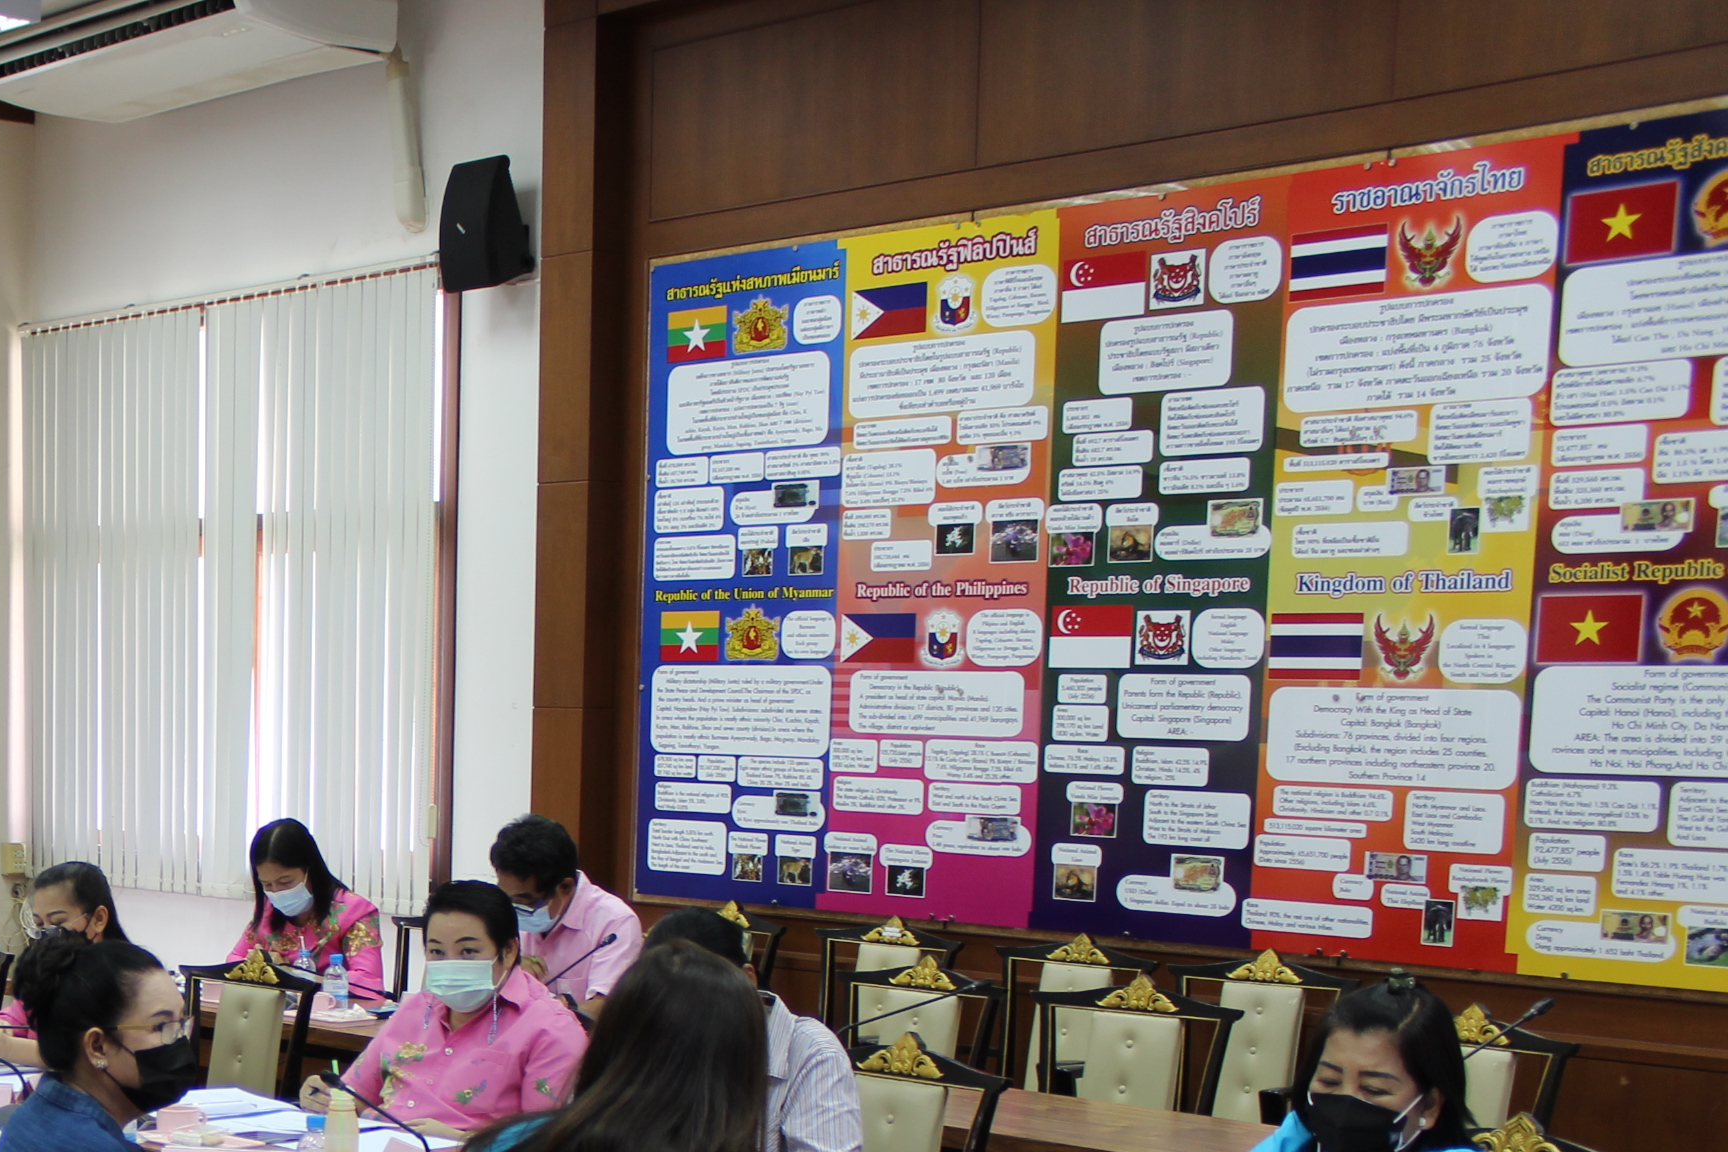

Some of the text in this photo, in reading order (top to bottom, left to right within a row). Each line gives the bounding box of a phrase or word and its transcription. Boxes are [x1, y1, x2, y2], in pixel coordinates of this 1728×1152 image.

[1332, 161, 1524, 214] ราชอาณาจักรไทย
[1085, 195, 1262, 248] สาธารณรัฐสิงคโปร์
[872, 227, 1038, 276] สาธารณรัฐฟิลิปปินส์
[666, 260, 841, 300] สาธารณรัฐแห่งสหภาพเมียนมาร์
[1068, 574, 1251, 598] Republic of Singapore
[1295, 568, 1513, 598] Kingdom of Thailand
[1549, 559, 1724, 584] Socialist Republic
[655, 587, 834, 603] Republic of the Union of Myanmar
[856, 580, 1028, 601] Republic of the Philippines
